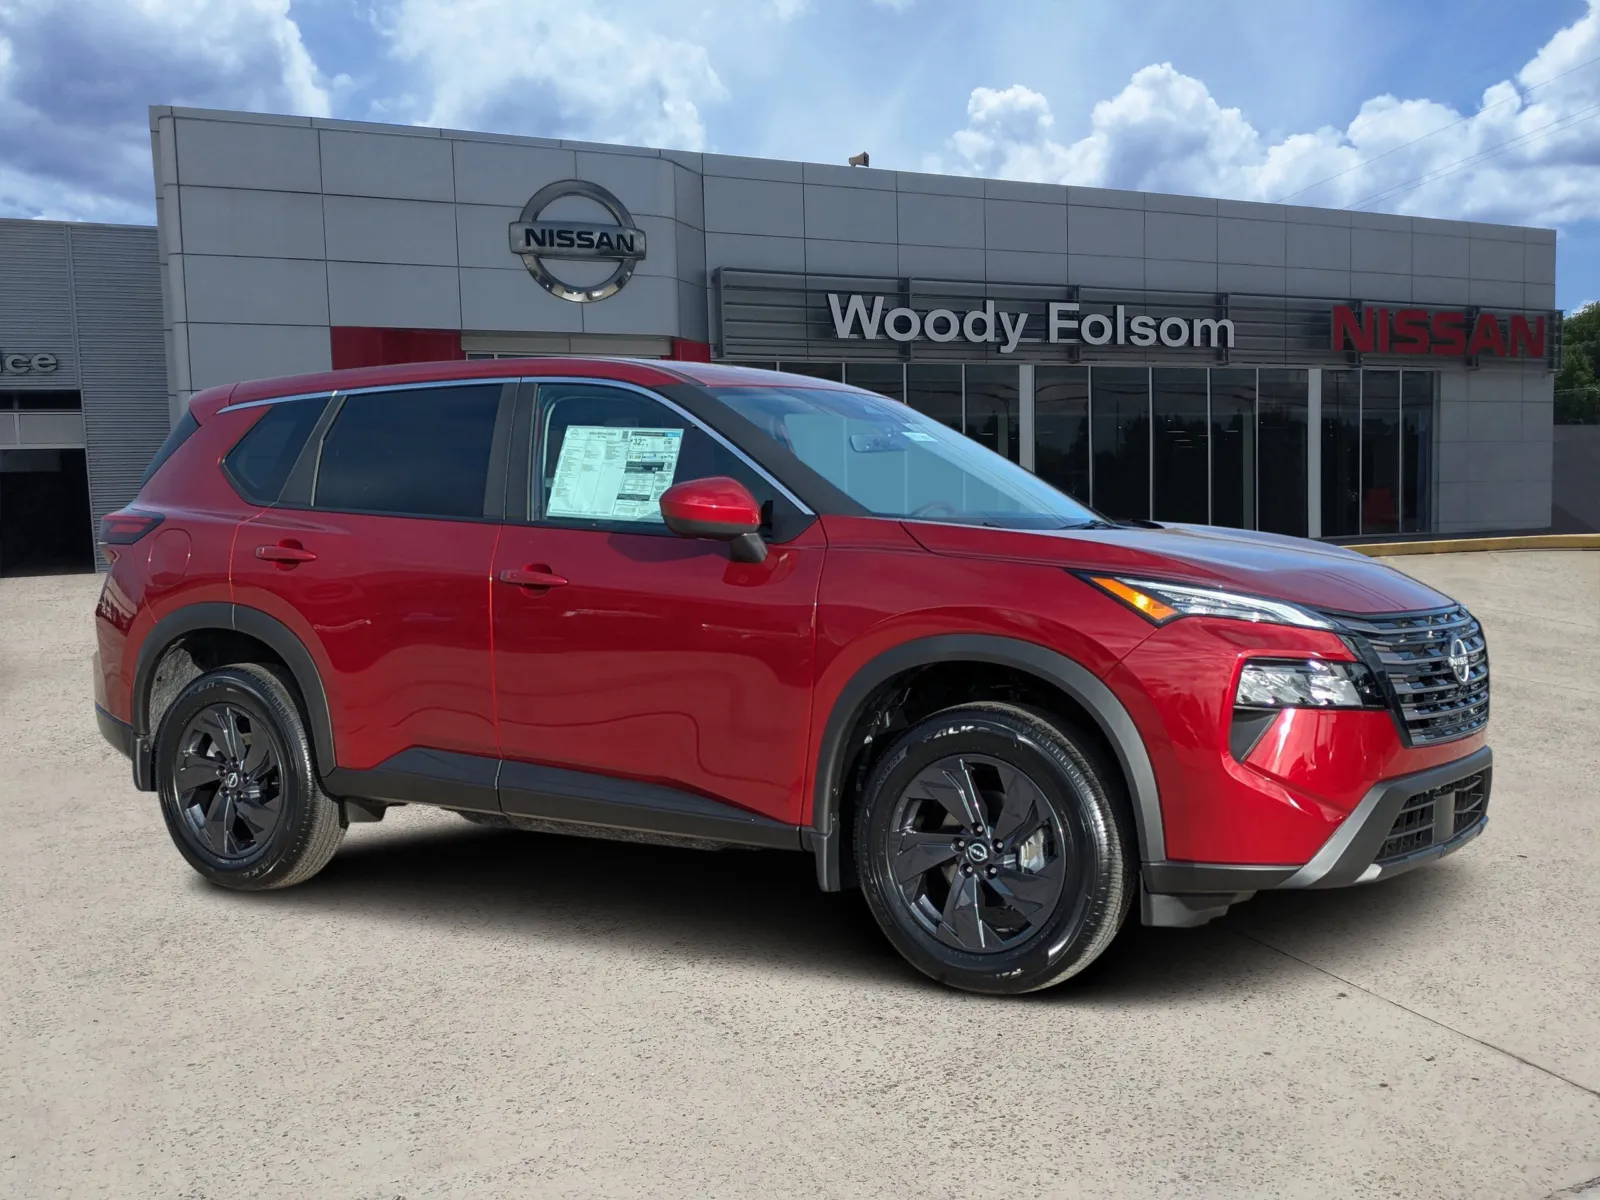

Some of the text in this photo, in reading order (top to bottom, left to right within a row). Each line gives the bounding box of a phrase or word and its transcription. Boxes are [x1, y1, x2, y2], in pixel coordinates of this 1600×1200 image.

[524, 228, 634, 252] NISSAN
[827, 293, 1235, 353] Woody Folsom
[1333, 305, 1545, 357] NISSAN
[0, 353, 58, 374] ce
[1451, 656, 1468, 666] NISS
